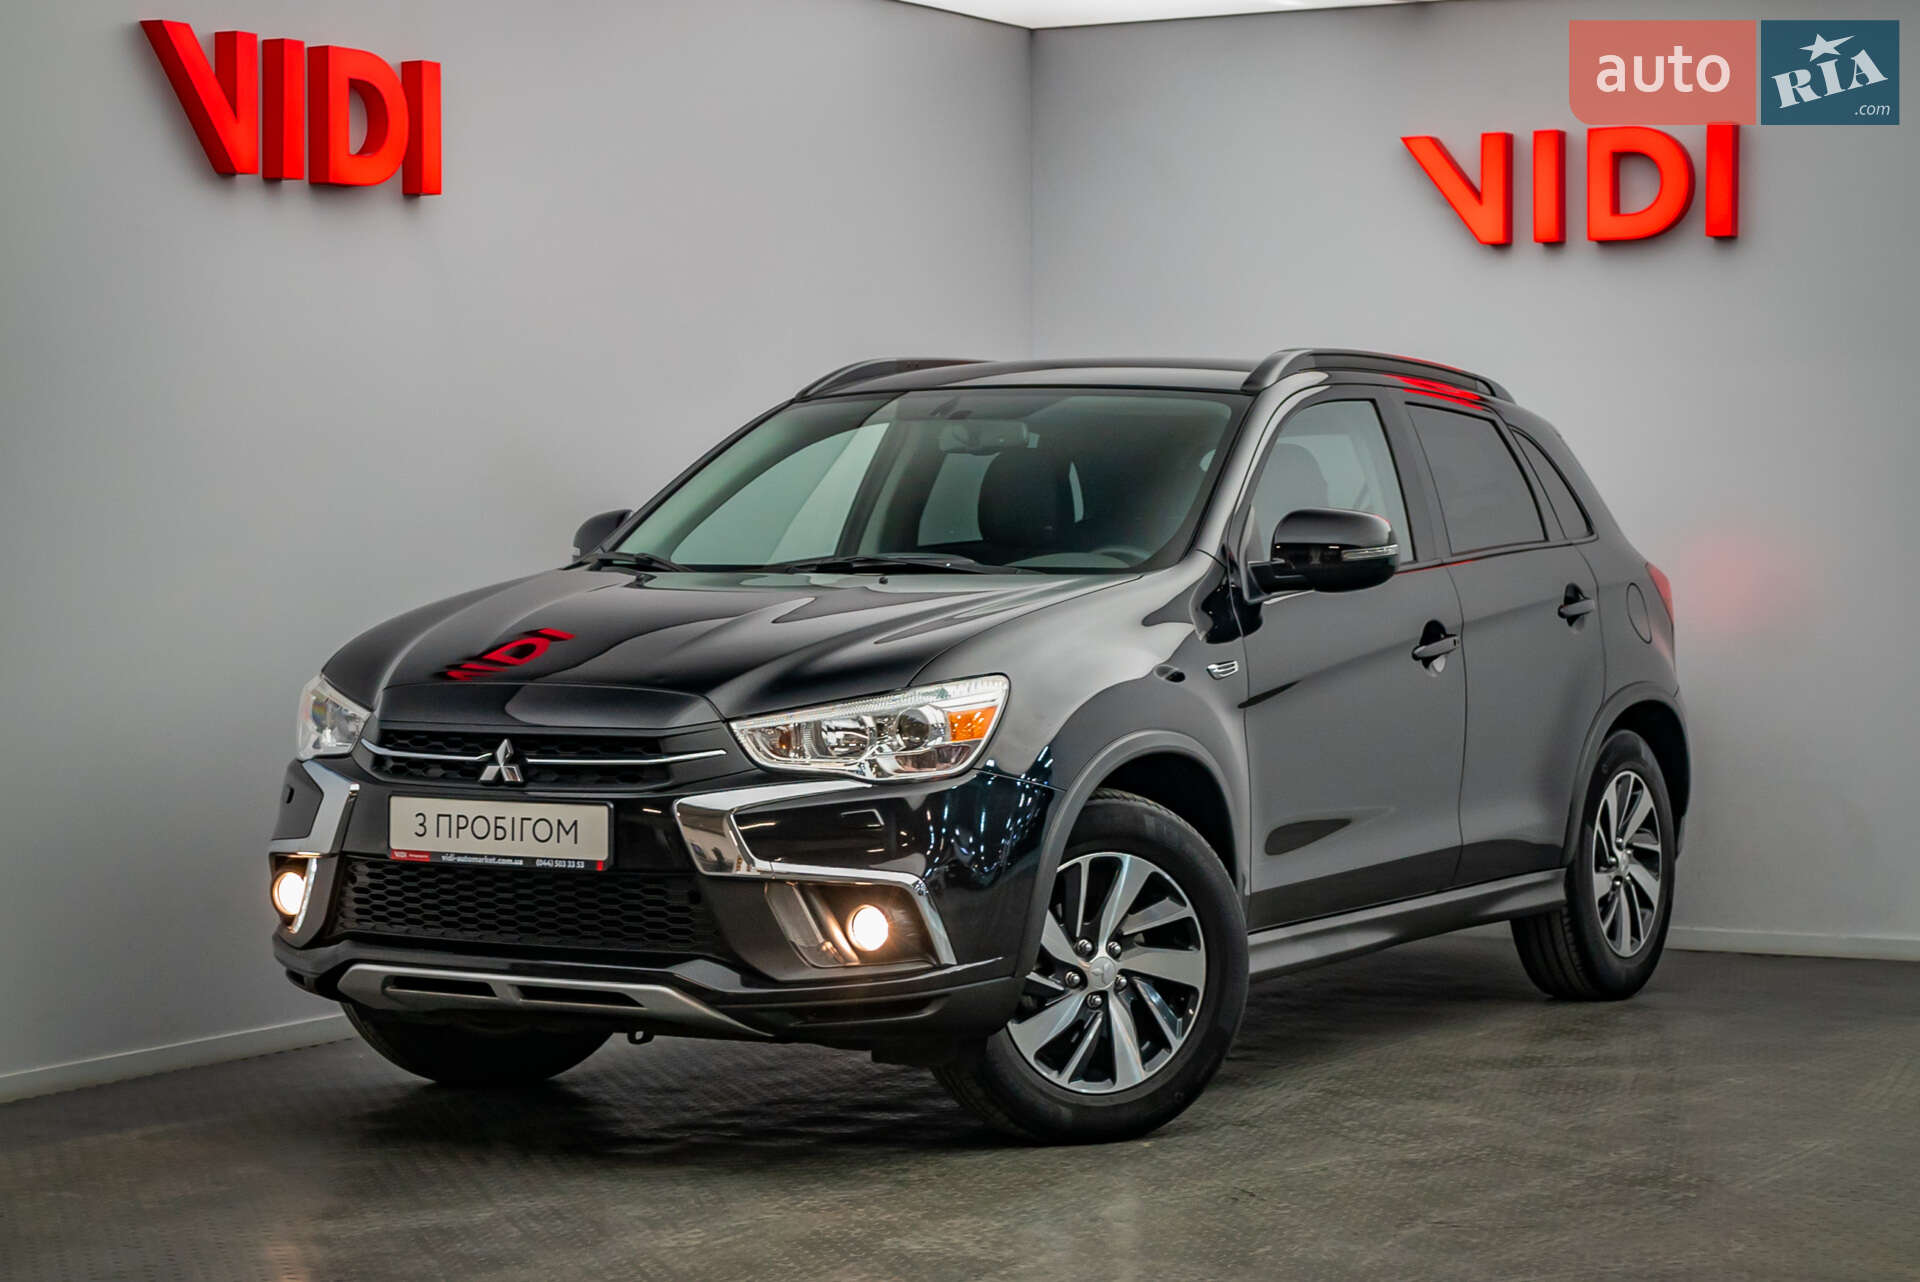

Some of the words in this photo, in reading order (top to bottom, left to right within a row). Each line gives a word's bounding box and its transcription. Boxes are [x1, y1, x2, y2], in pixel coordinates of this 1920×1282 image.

[140, 19, 442, 196] VIDI
[1400, 122, 1740, 246] VIDI
[435, 813, 579, 844] ПРОБІГОМ
